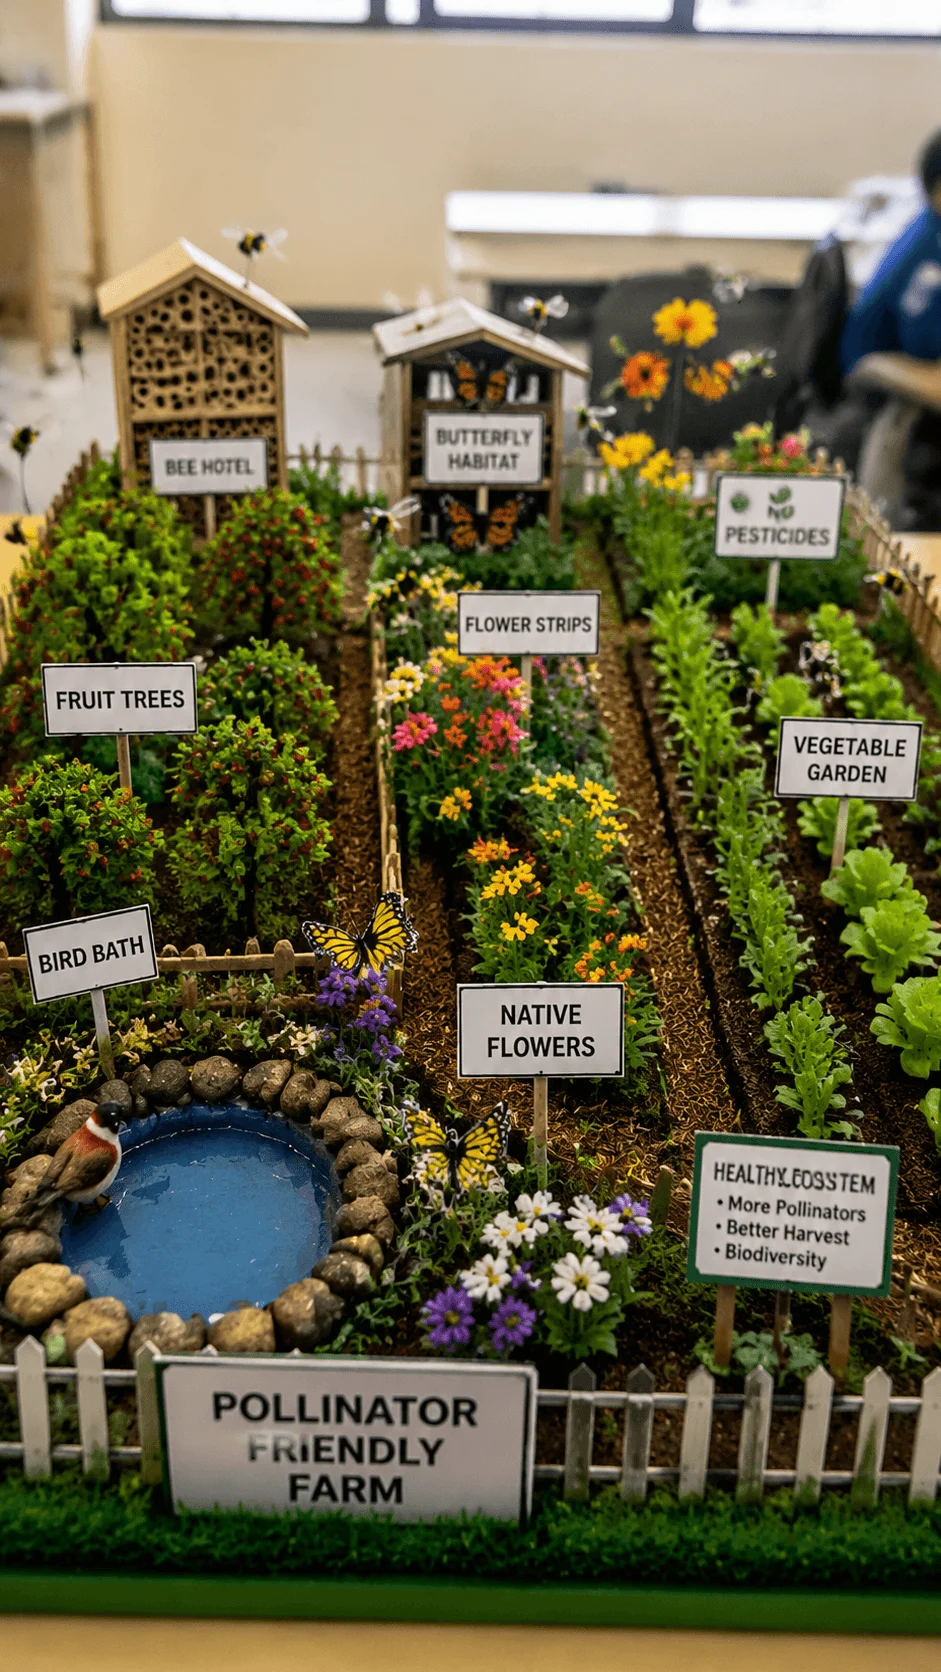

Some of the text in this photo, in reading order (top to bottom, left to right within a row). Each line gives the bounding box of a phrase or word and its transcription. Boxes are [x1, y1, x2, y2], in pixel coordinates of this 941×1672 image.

[436, 428, 533, 446] BUTTERFLY
[165, 457, 255, 476] BEE HOTEL
[448, 453, 520, 470] HABITAT
[725, 526, 830, 546] PESTICIDES
[465, 616, 592, 633] FLOWER STRIPS
[56, 689, 185, 710] FRUIT TREES
[794, 735, 907, 758] VEGETABLE
[807, 763, 887, 783] GARDEN
[38, 935, 145, 974] BIRD BATH
[501, 1004, 582, 1026] NATIVE
[487, 1036, 596, 1058] FLOWERS
[728, 1195, 866, 1223] More Pollinators
[727, 1219, 850, 1246] Better Harvest
[725, 1243, 827, 1272] Biodiversity
[212, 1391, 478, 1427] POLLINATOR
[248, 1432, 444, 1466] FRIENDLY
[289, 1473, 403, 1504] FARM
